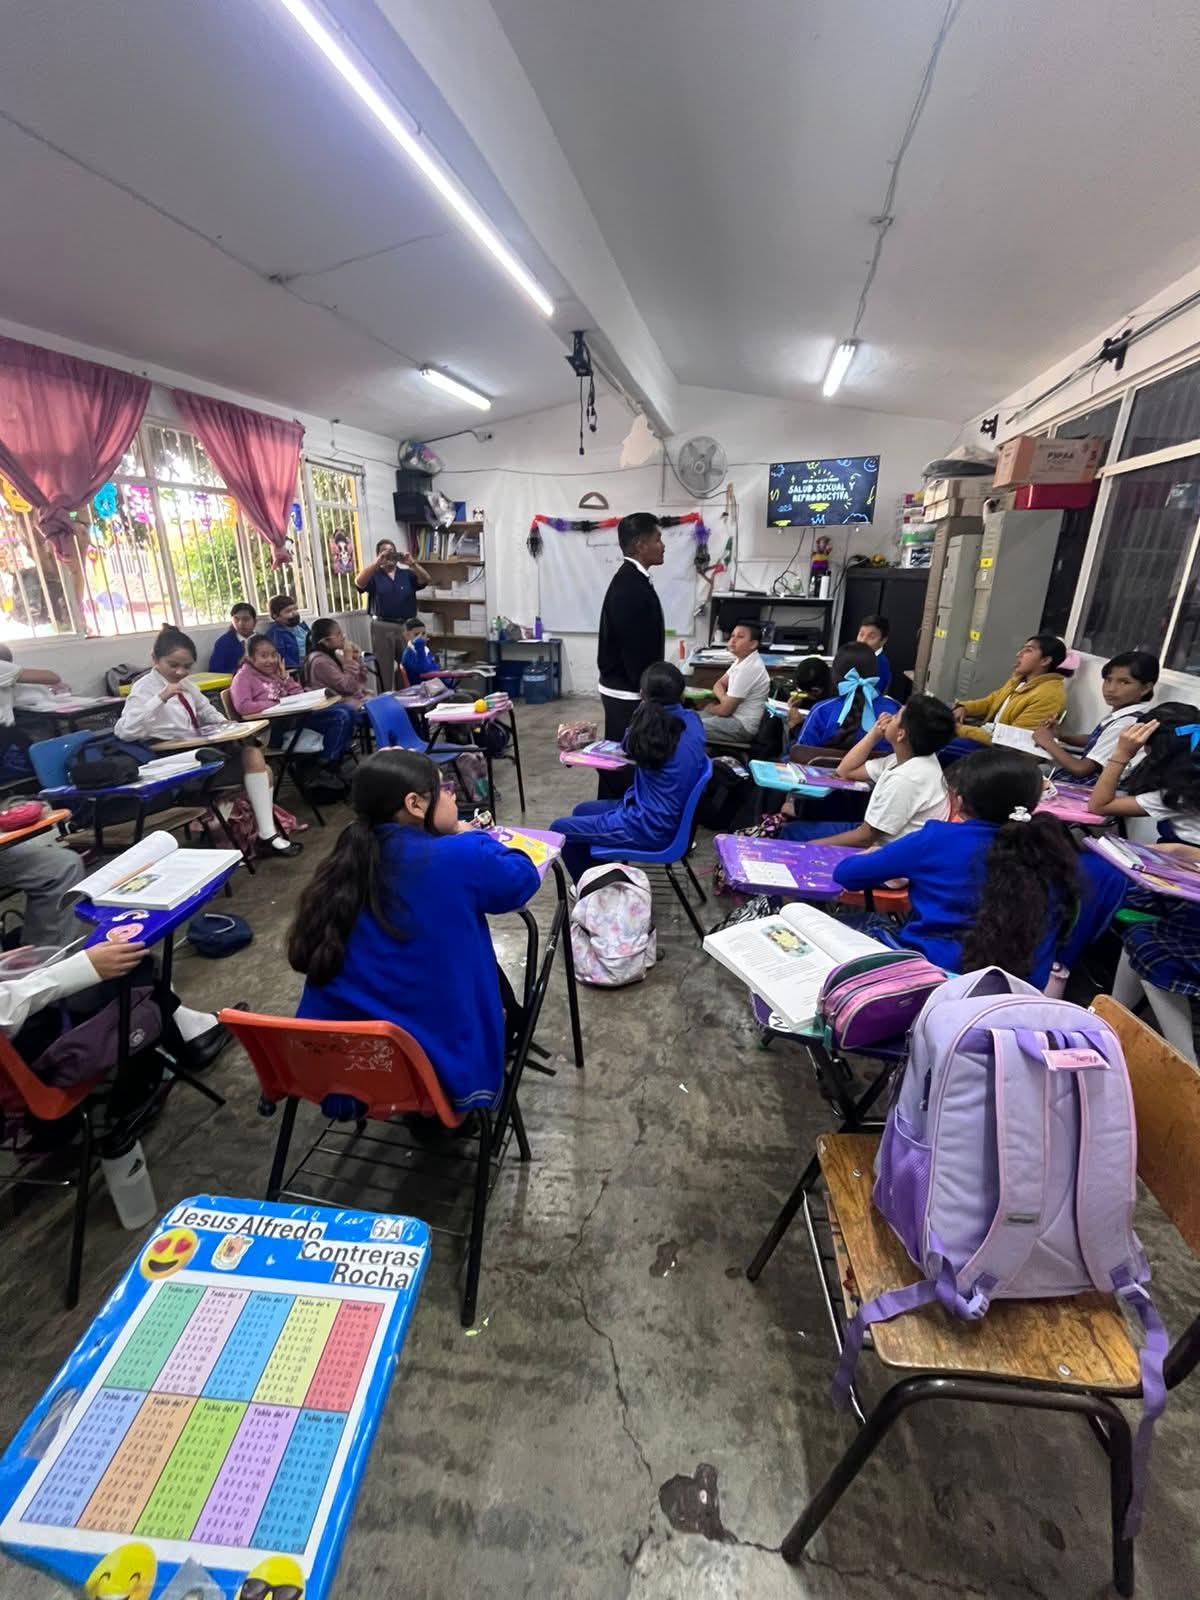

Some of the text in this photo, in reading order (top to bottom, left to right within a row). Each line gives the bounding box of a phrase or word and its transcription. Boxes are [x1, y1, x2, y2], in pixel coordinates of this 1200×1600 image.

[788, 482, 856, 494] SALUD SEXUAL Y
[792, 492, 849, 502] REPRODUCTIVA
[172, 1208, 323, 1240] Jesus Alfredo
[301, 1240, 420, 1267] Contreras
[331, 1263, 410, 1288] Rocha
